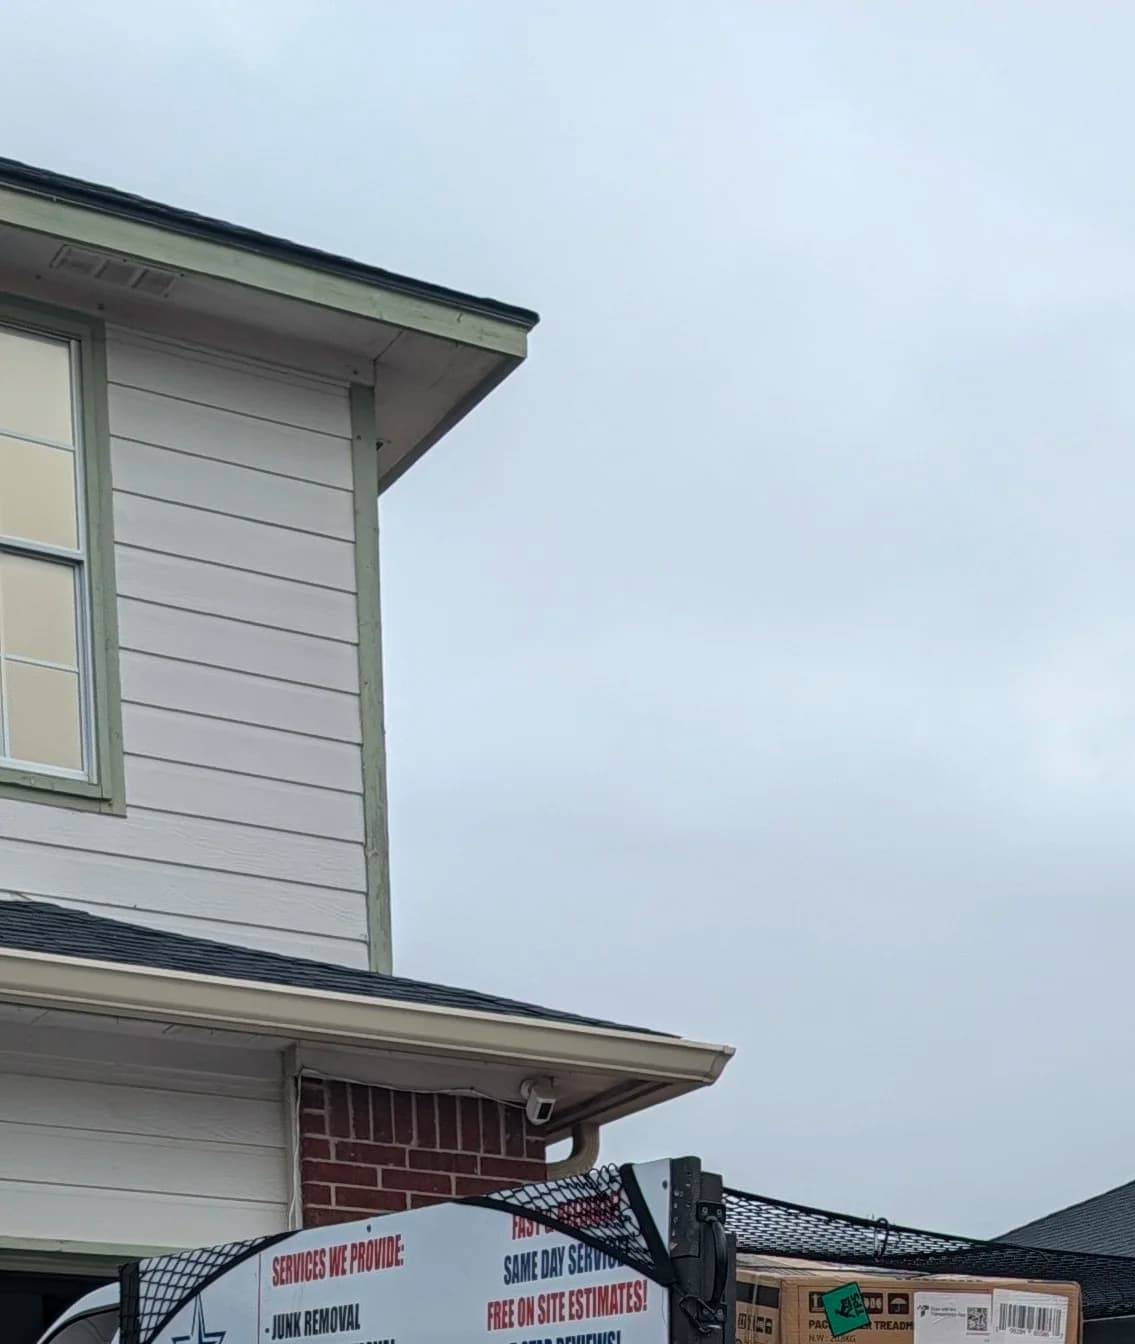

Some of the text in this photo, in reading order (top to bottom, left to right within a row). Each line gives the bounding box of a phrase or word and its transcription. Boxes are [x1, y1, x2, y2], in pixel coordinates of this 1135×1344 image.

[272, 1234, 405, 1287] SERVICES WE PROVIDE:
[503, 1249, 538, 1285] SAME
[541, 1245, 565, 1280] DAY
[271, 1303, 361, 1340] JUNK REMOVAL
[487, 1280, 648, 1331] FREE ON SITE ESTIMATES!
